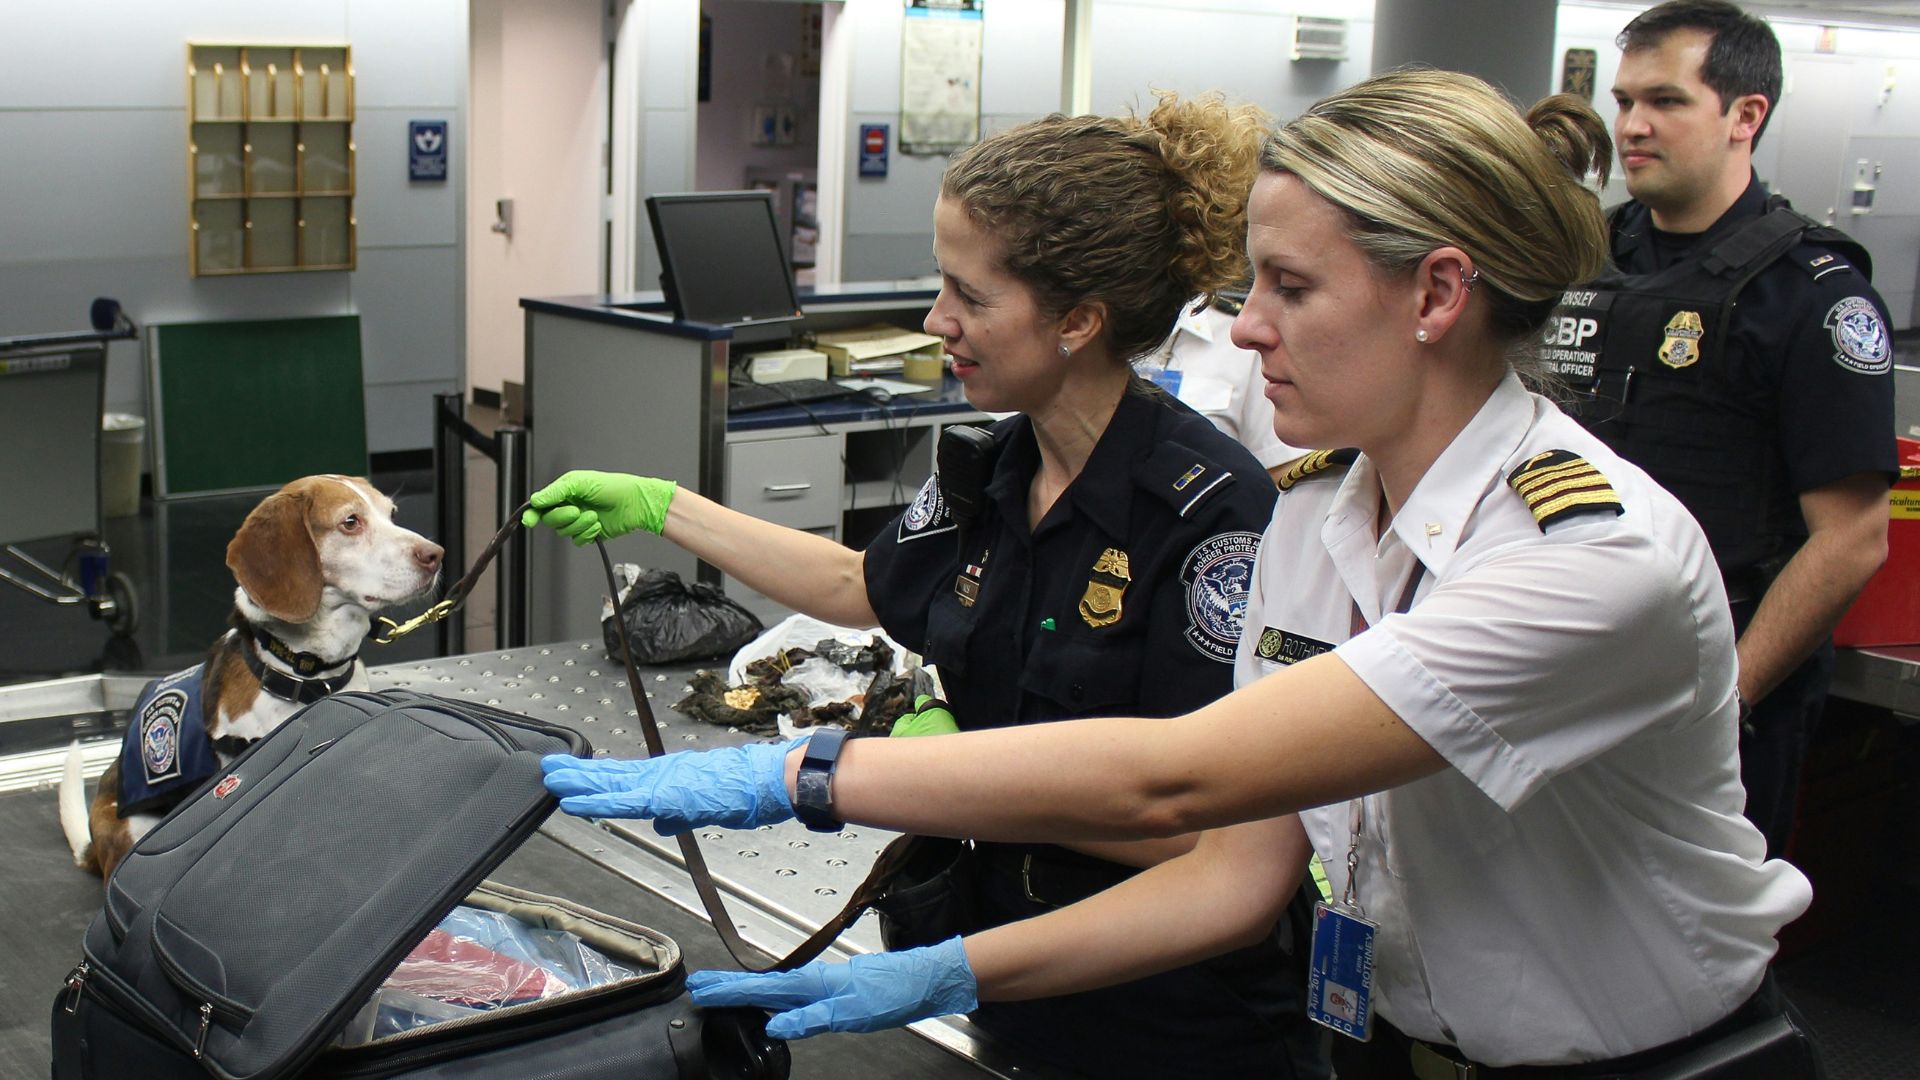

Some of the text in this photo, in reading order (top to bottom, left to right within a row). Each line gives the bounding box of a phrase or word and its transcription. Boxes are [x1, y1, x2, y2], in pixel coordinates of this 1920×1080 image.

[1544, 316, 1598, 347] CBP
[1552, 350, 1596, 364] OPERATIONS
[1561, 363, 1594, 377] OFFICER
[1193, 544, 1258, 573] BORDER PROTEC
[1196, 547, 1211, 559] U.S.
[1211, 536, 1252, 550] CUSTOMS
[1210, 643, 1234, 656] FIELD
[1282, 638, 1327, 658] ROTHN
[1361, 932, 1373, 989] ROTHNEY
[1312, 967, 1321, 992] 2017
